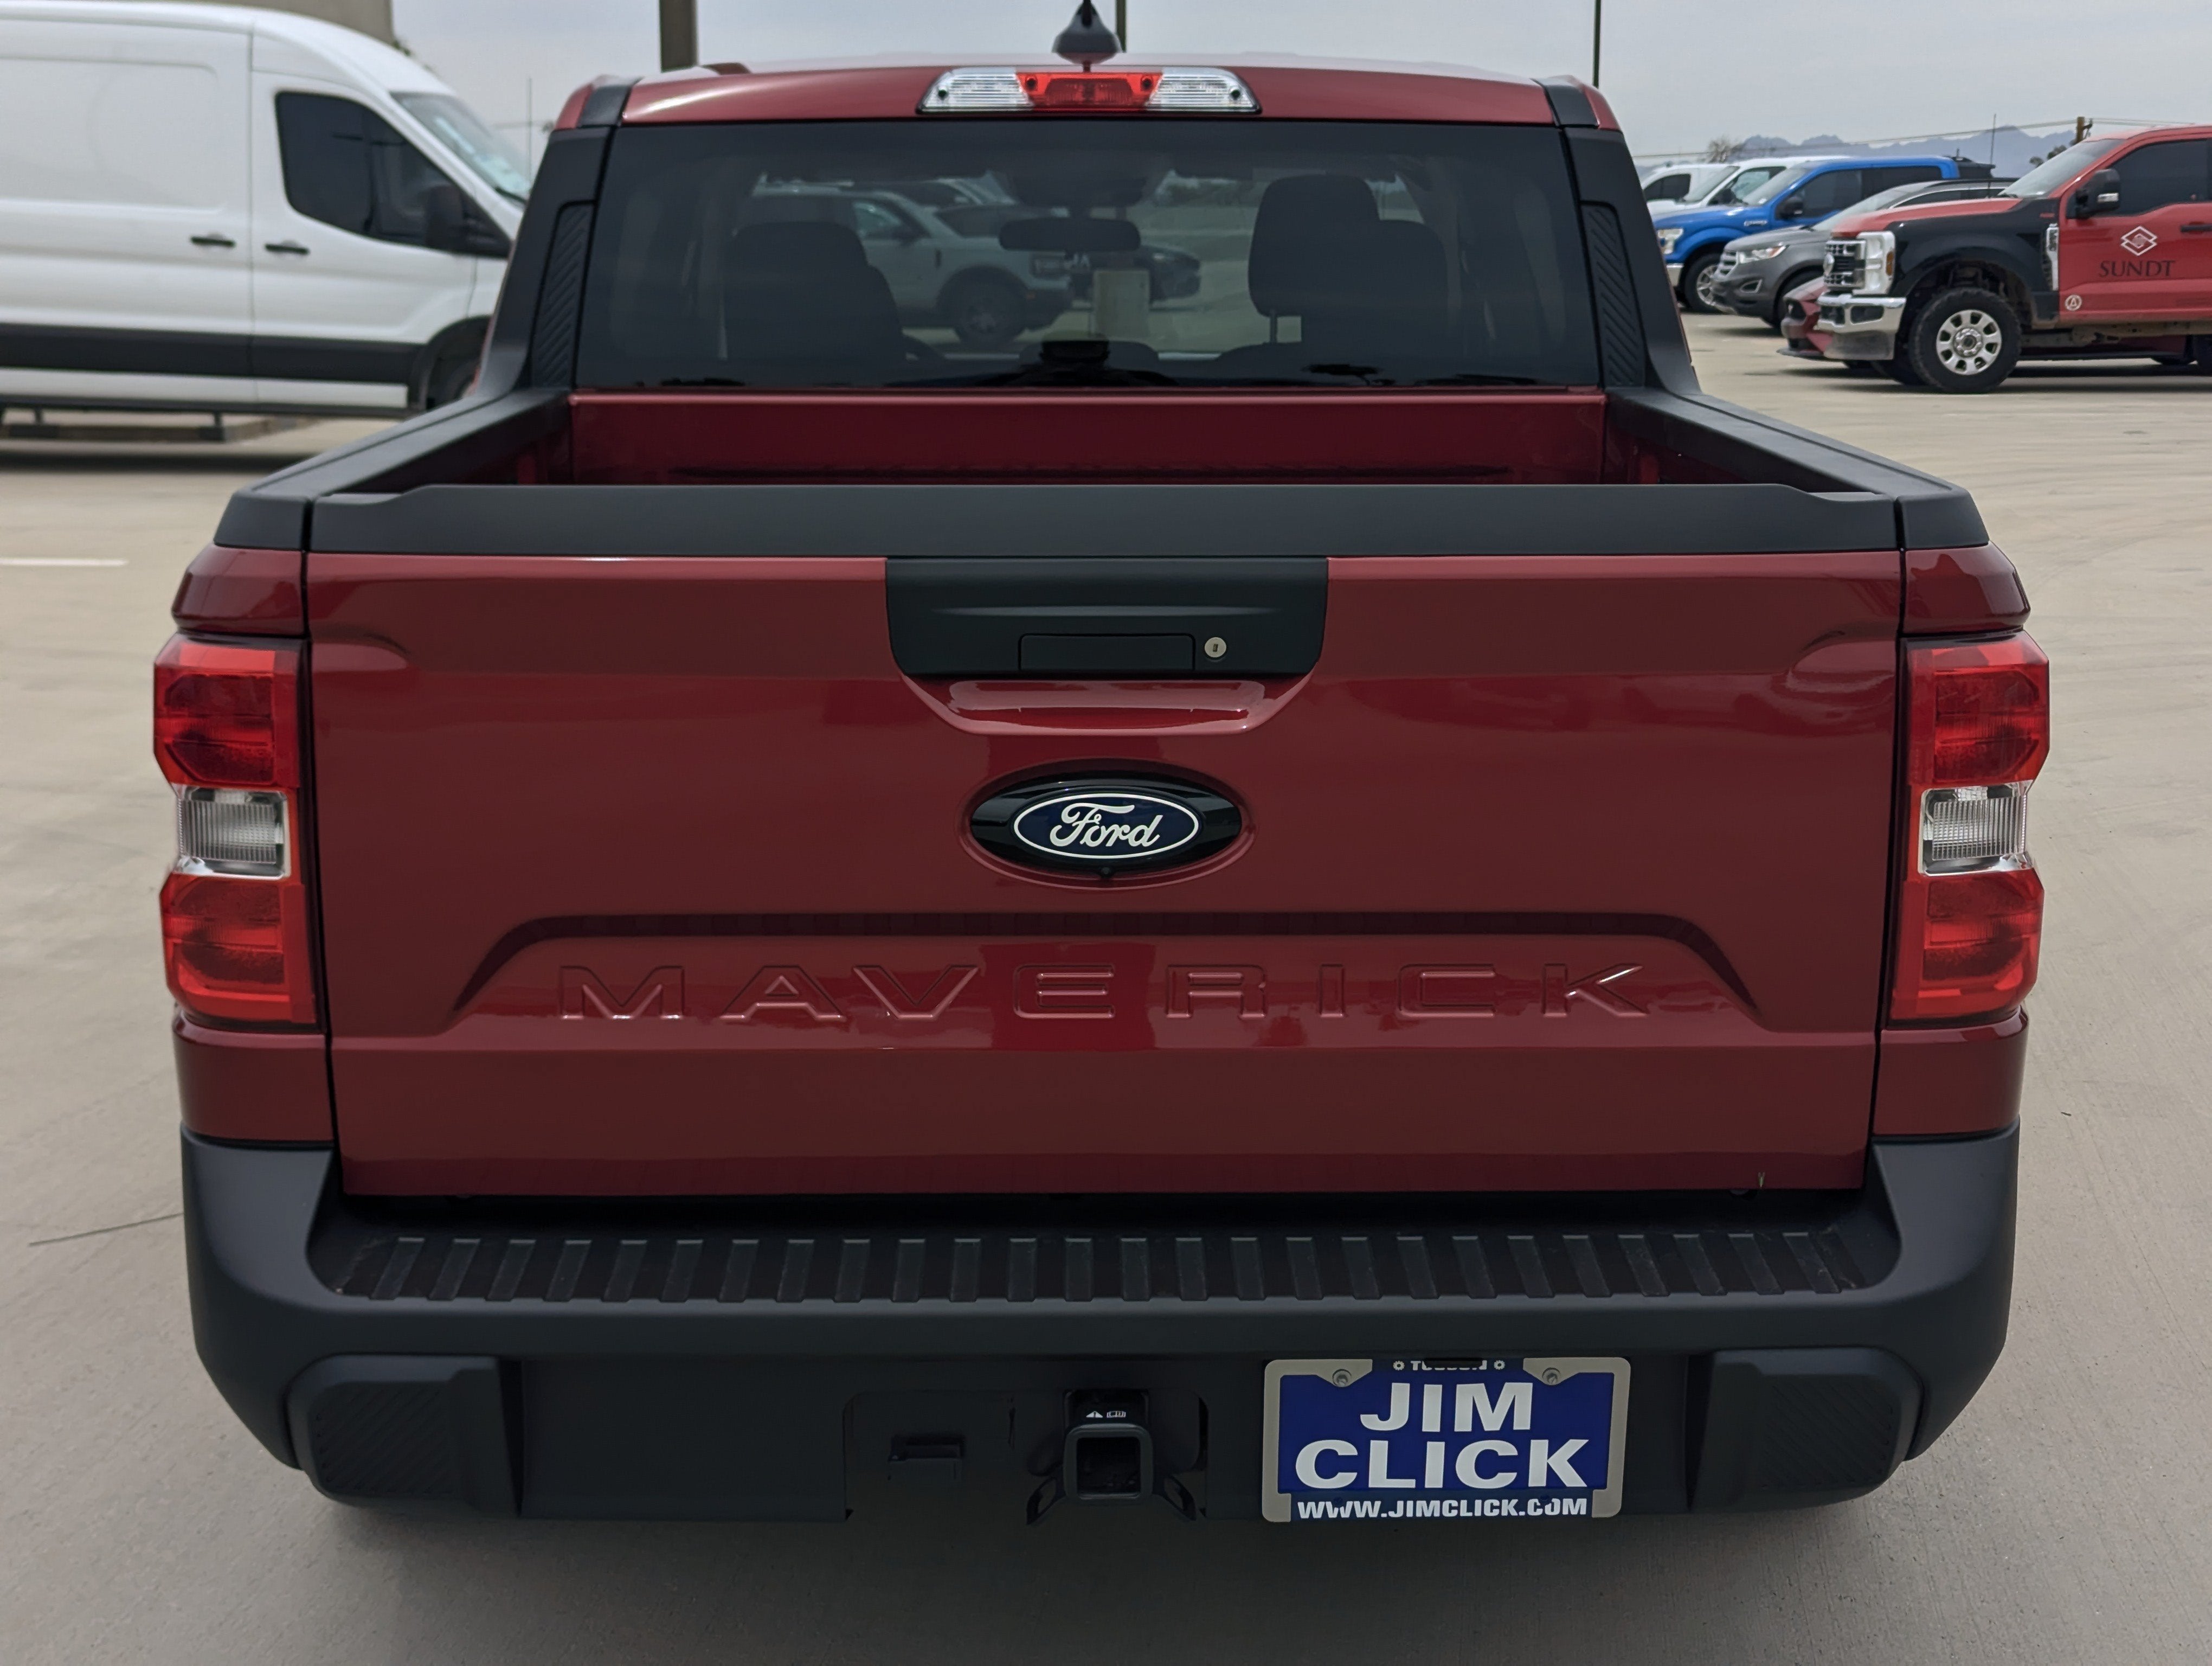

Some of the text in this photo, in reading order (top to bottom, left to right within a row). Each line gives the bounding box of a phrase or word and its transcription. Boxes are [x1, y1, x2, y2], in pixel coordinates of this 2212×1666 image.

[2099, 260, 2176, 277] SUNDT
[1050, 803, 1163, 848] Ford
[559, 964, 1649, 1020] MAVERICK
[1360, 1382, 1533, 1432] JIM
[1295, 1439, 1589, 1489] CLICK
[1297, 1498, 1587, 1518] WWW.JIMCLICK.COM
